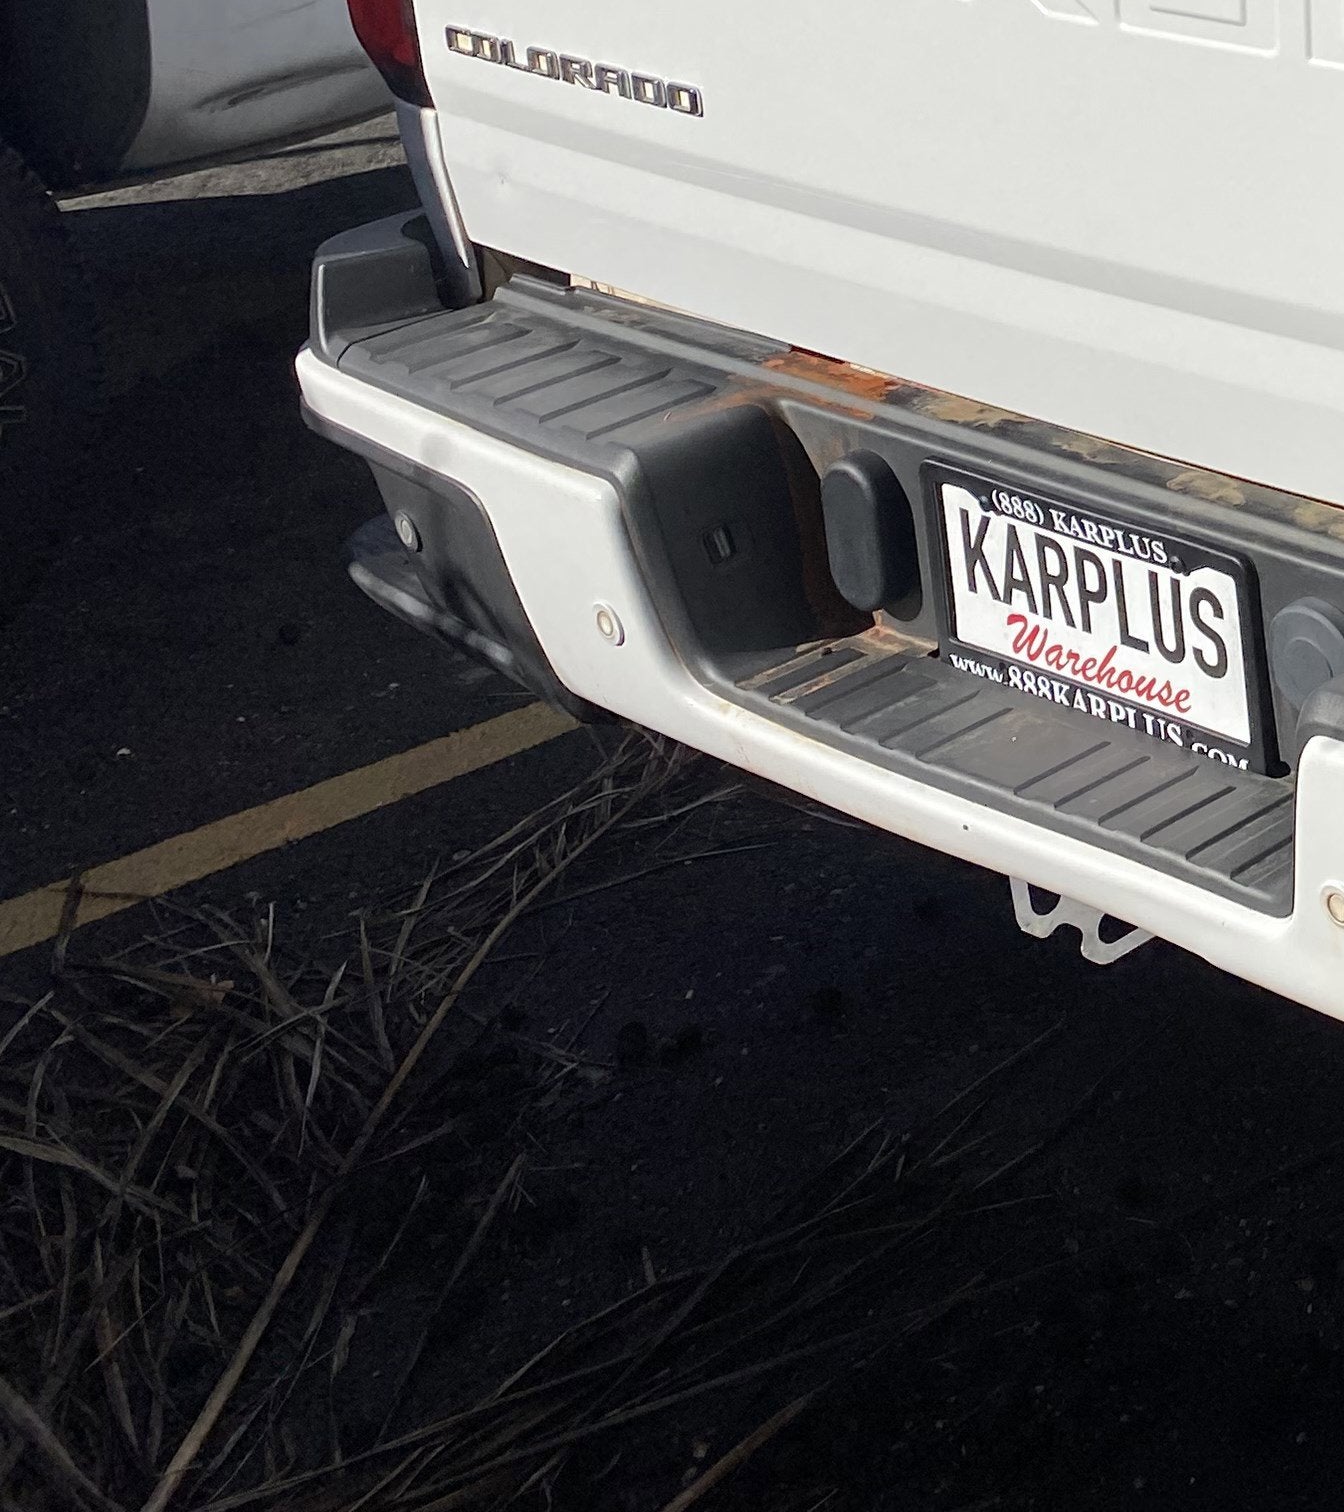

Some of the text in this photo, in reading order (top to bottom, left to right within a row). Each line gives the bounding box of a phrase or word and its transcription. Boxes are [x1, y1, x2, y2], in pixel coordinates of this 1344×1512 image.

[445, 24, 705, 118] COLORADO
[992, 489, 1168, 563] (888) KARPLUS
[958, 507, 1228, 679] KARPLUS
[1006, 613, 1192, 714] Warehouse
